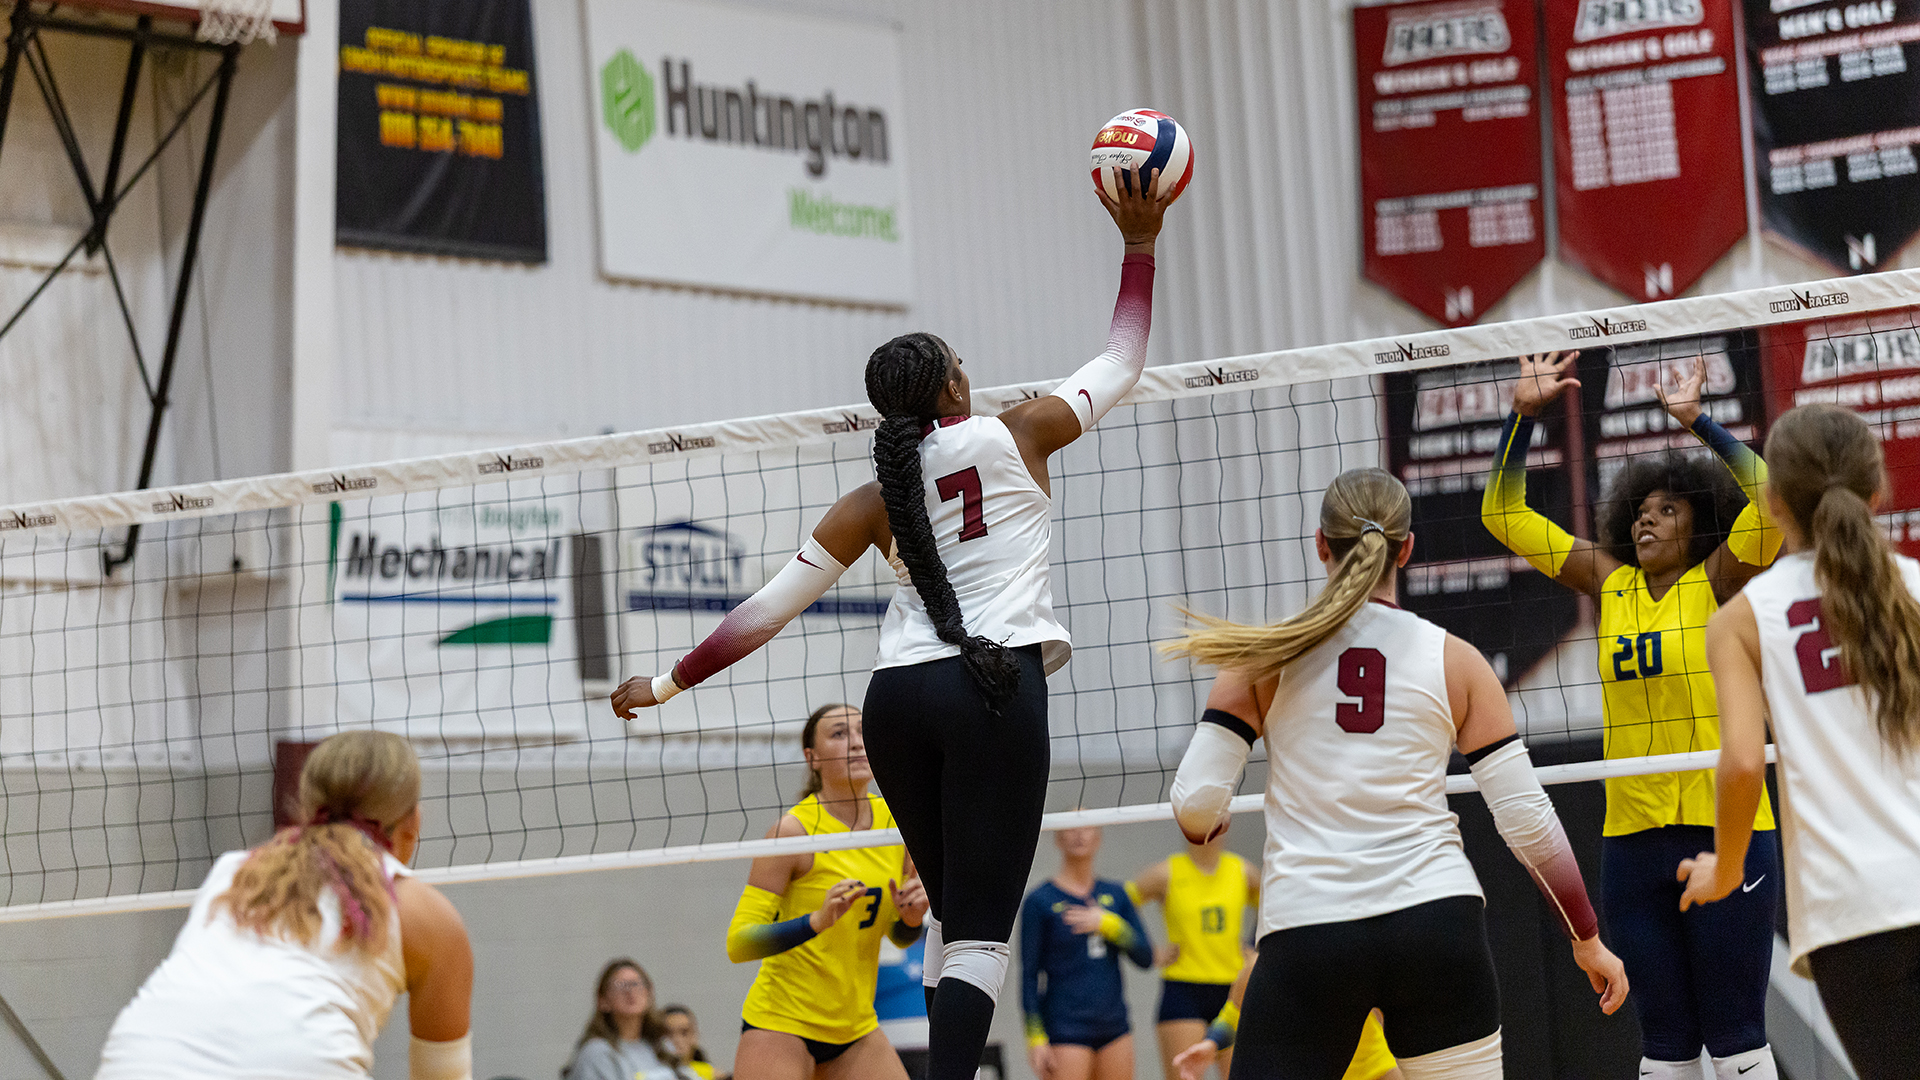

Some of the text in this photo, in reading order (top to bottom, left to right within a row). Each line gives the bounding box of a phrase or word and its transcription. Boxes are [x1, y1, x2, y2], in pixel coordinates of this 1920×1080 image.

[1779, 0, 1896, 40] MEN'S GOLF
[1566, 28, 1715, 72] WOMEN'S GOLF
[662, 54, 892, 178] Huntington
[1109, 151, 1133, 165] Super
[1769, 299, 1799, 314] UNOH
[1808, 292, 1849, 309] RACERS
[1569, 325, 1599, 341] UNOH
[1607, 320, 1647, 335] RACERS
[1375, 350, 1404, 365] UNOH
[1412, 345, 1450, 359] RACERS
[1185, 375, 1214, 389] UNOH
[1221, 369, 1259, 384] RACERS
[680, 436, 716, 450] RACERS
[934, 465, 989, 543] 7
[345, 532, 562, 580] Mechanical
[643, 540, 746, 588] STOLLY
[1612, 631, 1663, 682] 20
[1335, 647, 1386, 734] 9
[859, 887, 882, 930] 3
